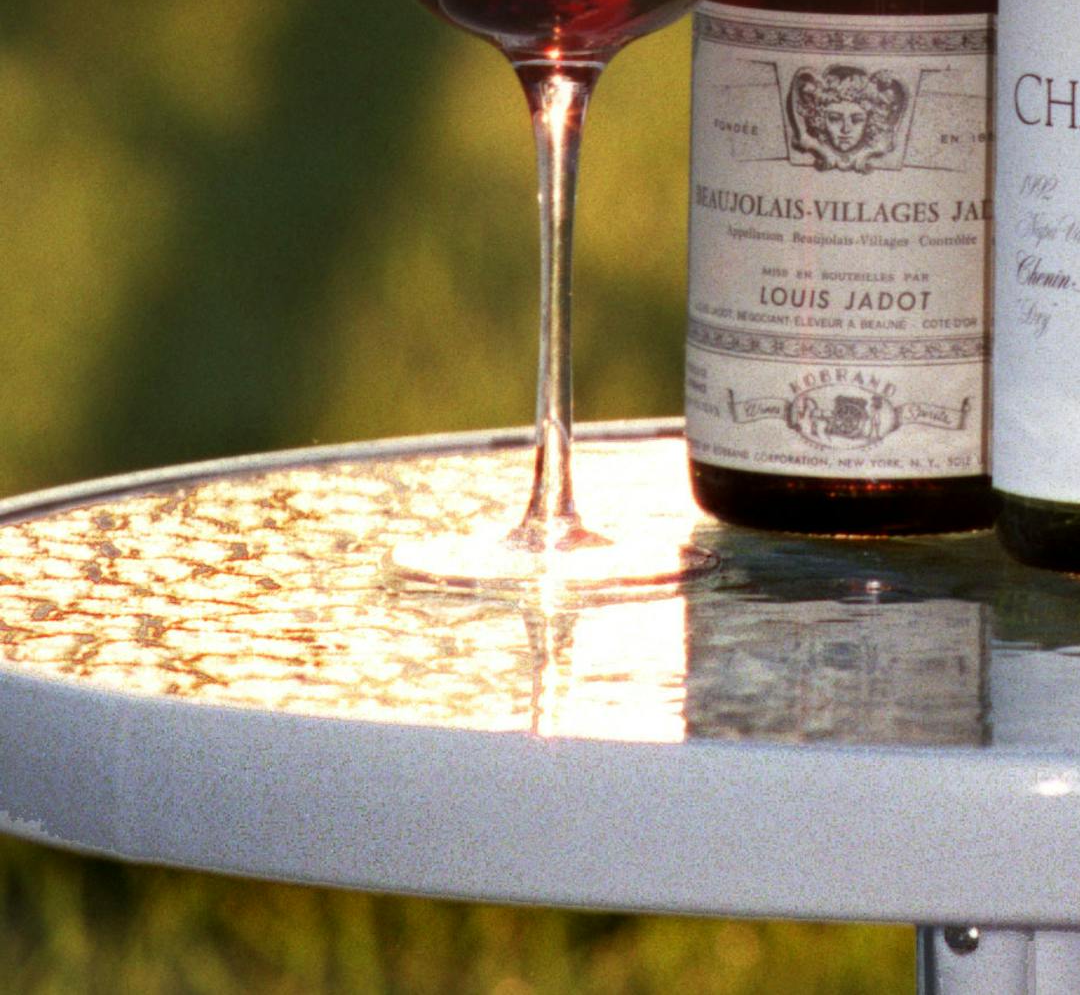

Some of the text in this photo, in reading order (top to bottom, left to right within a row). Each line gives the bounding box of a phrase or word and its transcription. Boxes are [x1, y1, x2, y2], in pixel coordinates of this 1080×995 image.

[940, 133, 960, 145] EN
[1015, 250, 1071, 290] Chenin
[760, 285, 932, 311] LOUIS JADOT
